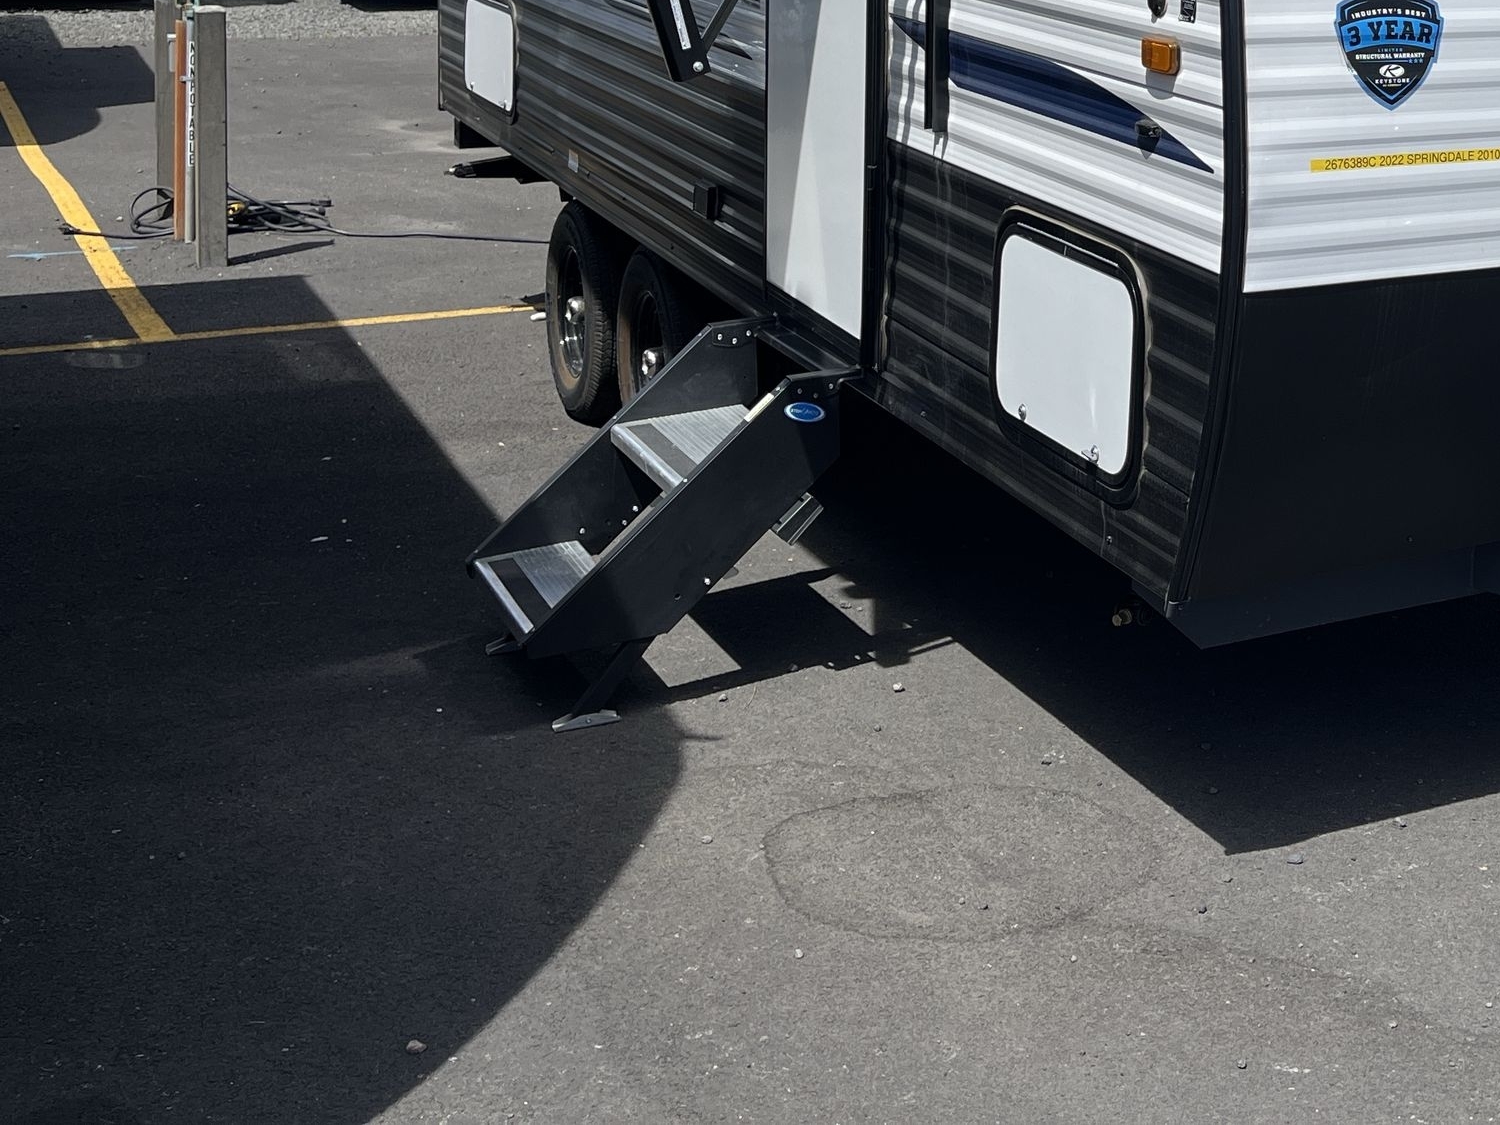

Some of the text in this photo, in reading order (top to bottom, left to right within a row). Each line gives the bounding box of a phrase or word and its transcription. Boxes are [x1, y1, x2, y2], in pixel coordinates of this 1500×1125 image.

[1351, 8, 1426, 20] INDUSTRY'S BEST
[1346, 19, 1433, 47] 3 YEAR
[1324, 156, 1377, 171] 2676389C
[1379, 154, 1404, 167] 2022
[1406, 150, 1474, 165] SPRINGDALE
